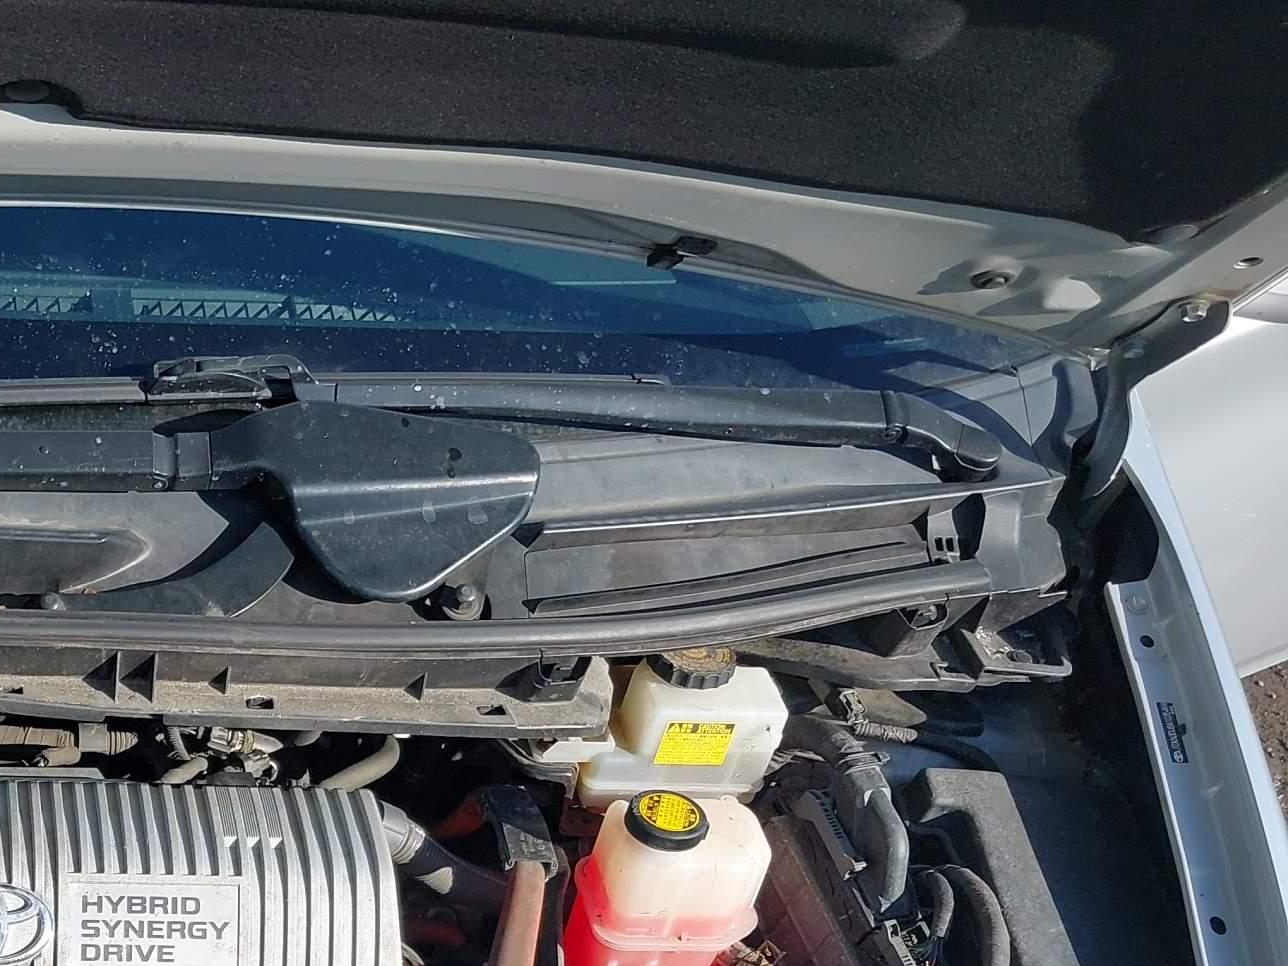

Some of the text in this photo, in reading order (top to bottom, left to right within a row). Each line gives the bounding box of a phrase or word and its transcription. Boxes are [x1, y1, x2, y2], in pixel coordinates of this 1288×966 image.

[81, 895, 201, 915] HYBRID
[81, 919, 229, 940] SYNERGY
[81, 944, 175, 962] DRIVE
